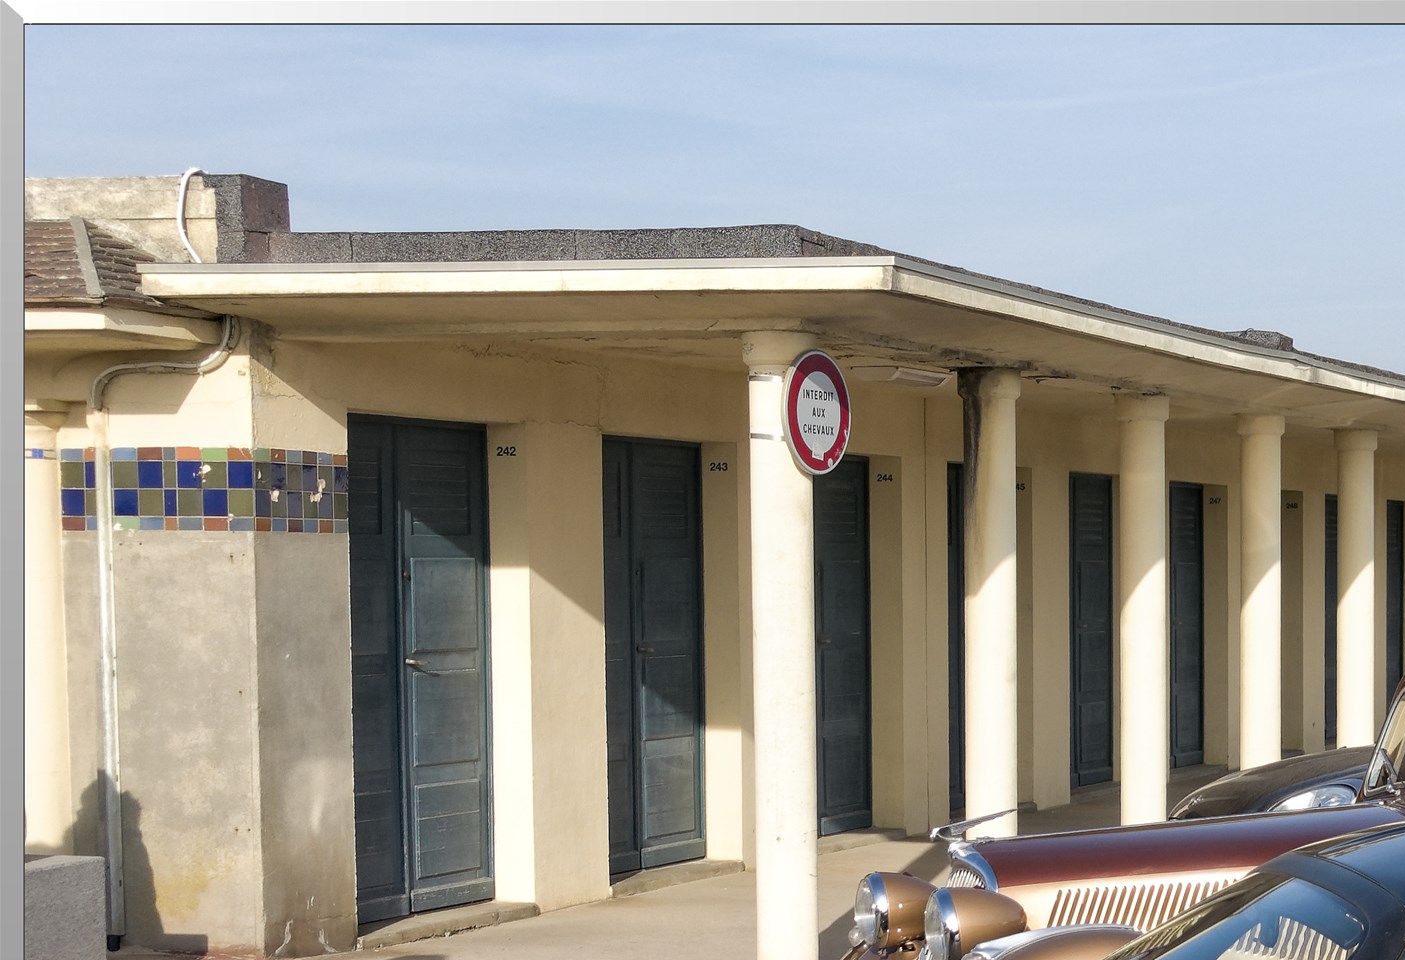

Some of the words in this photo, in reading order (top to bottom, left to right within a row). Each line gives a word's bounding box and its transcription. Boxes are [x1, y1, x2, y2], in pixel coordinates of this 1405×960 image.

[802, 388, 834, 402] INTERDIT
[811, 407, 826, 419] AUX
[802, 423, 835, 436] CHEVAUX
[496, 446, 517, 457] 242
[709, 462, 729, 472] 243
[876, 474, 893, 482] 244
[1016, 482, 1026, 491] 45
[1209, 497, 1222, 505] 247
